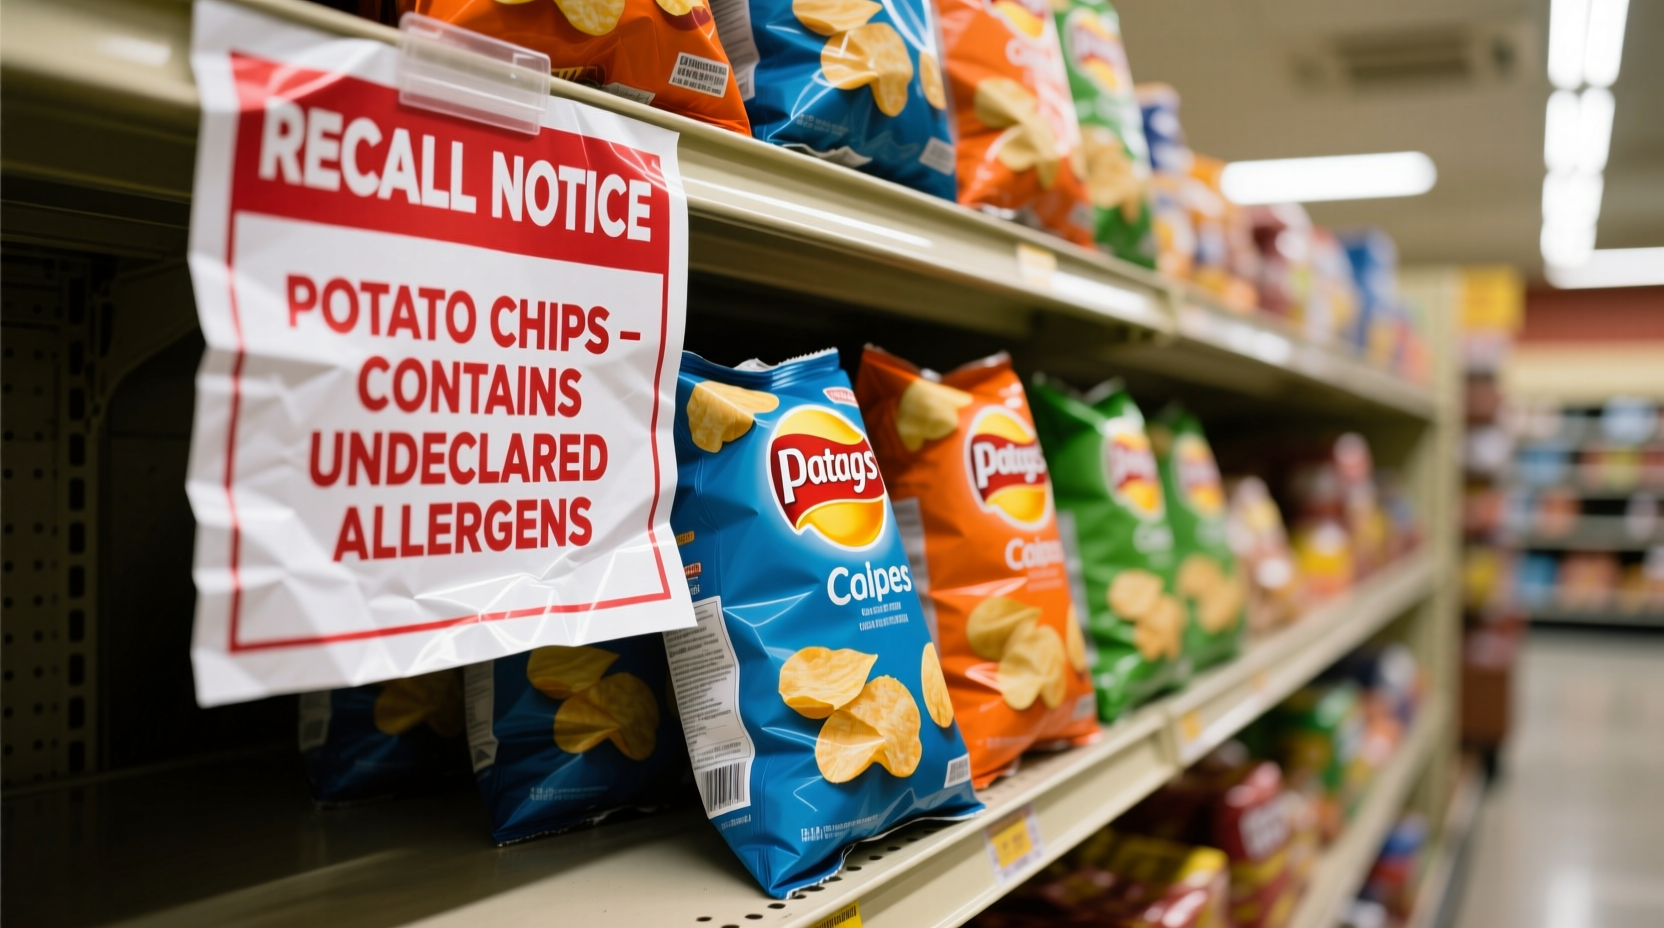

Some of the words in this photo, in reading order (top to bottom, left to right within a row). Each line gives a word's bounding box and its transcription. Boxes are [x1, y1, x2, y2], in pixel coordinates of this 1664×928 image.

[258, 102, 476, 214] RECALL
[491, 151, 652, 242] NOTICE
[286, 274, 477, 345] POTATO
[490, 295, 609, 354] CHIPS
[357, 356, 582, 418] CONTAINS
[309, 431, 608, 487] UNDECLARED
[778, 448, 878, 505] Patags
[333, 497, 592, 562] ALLERGENS
